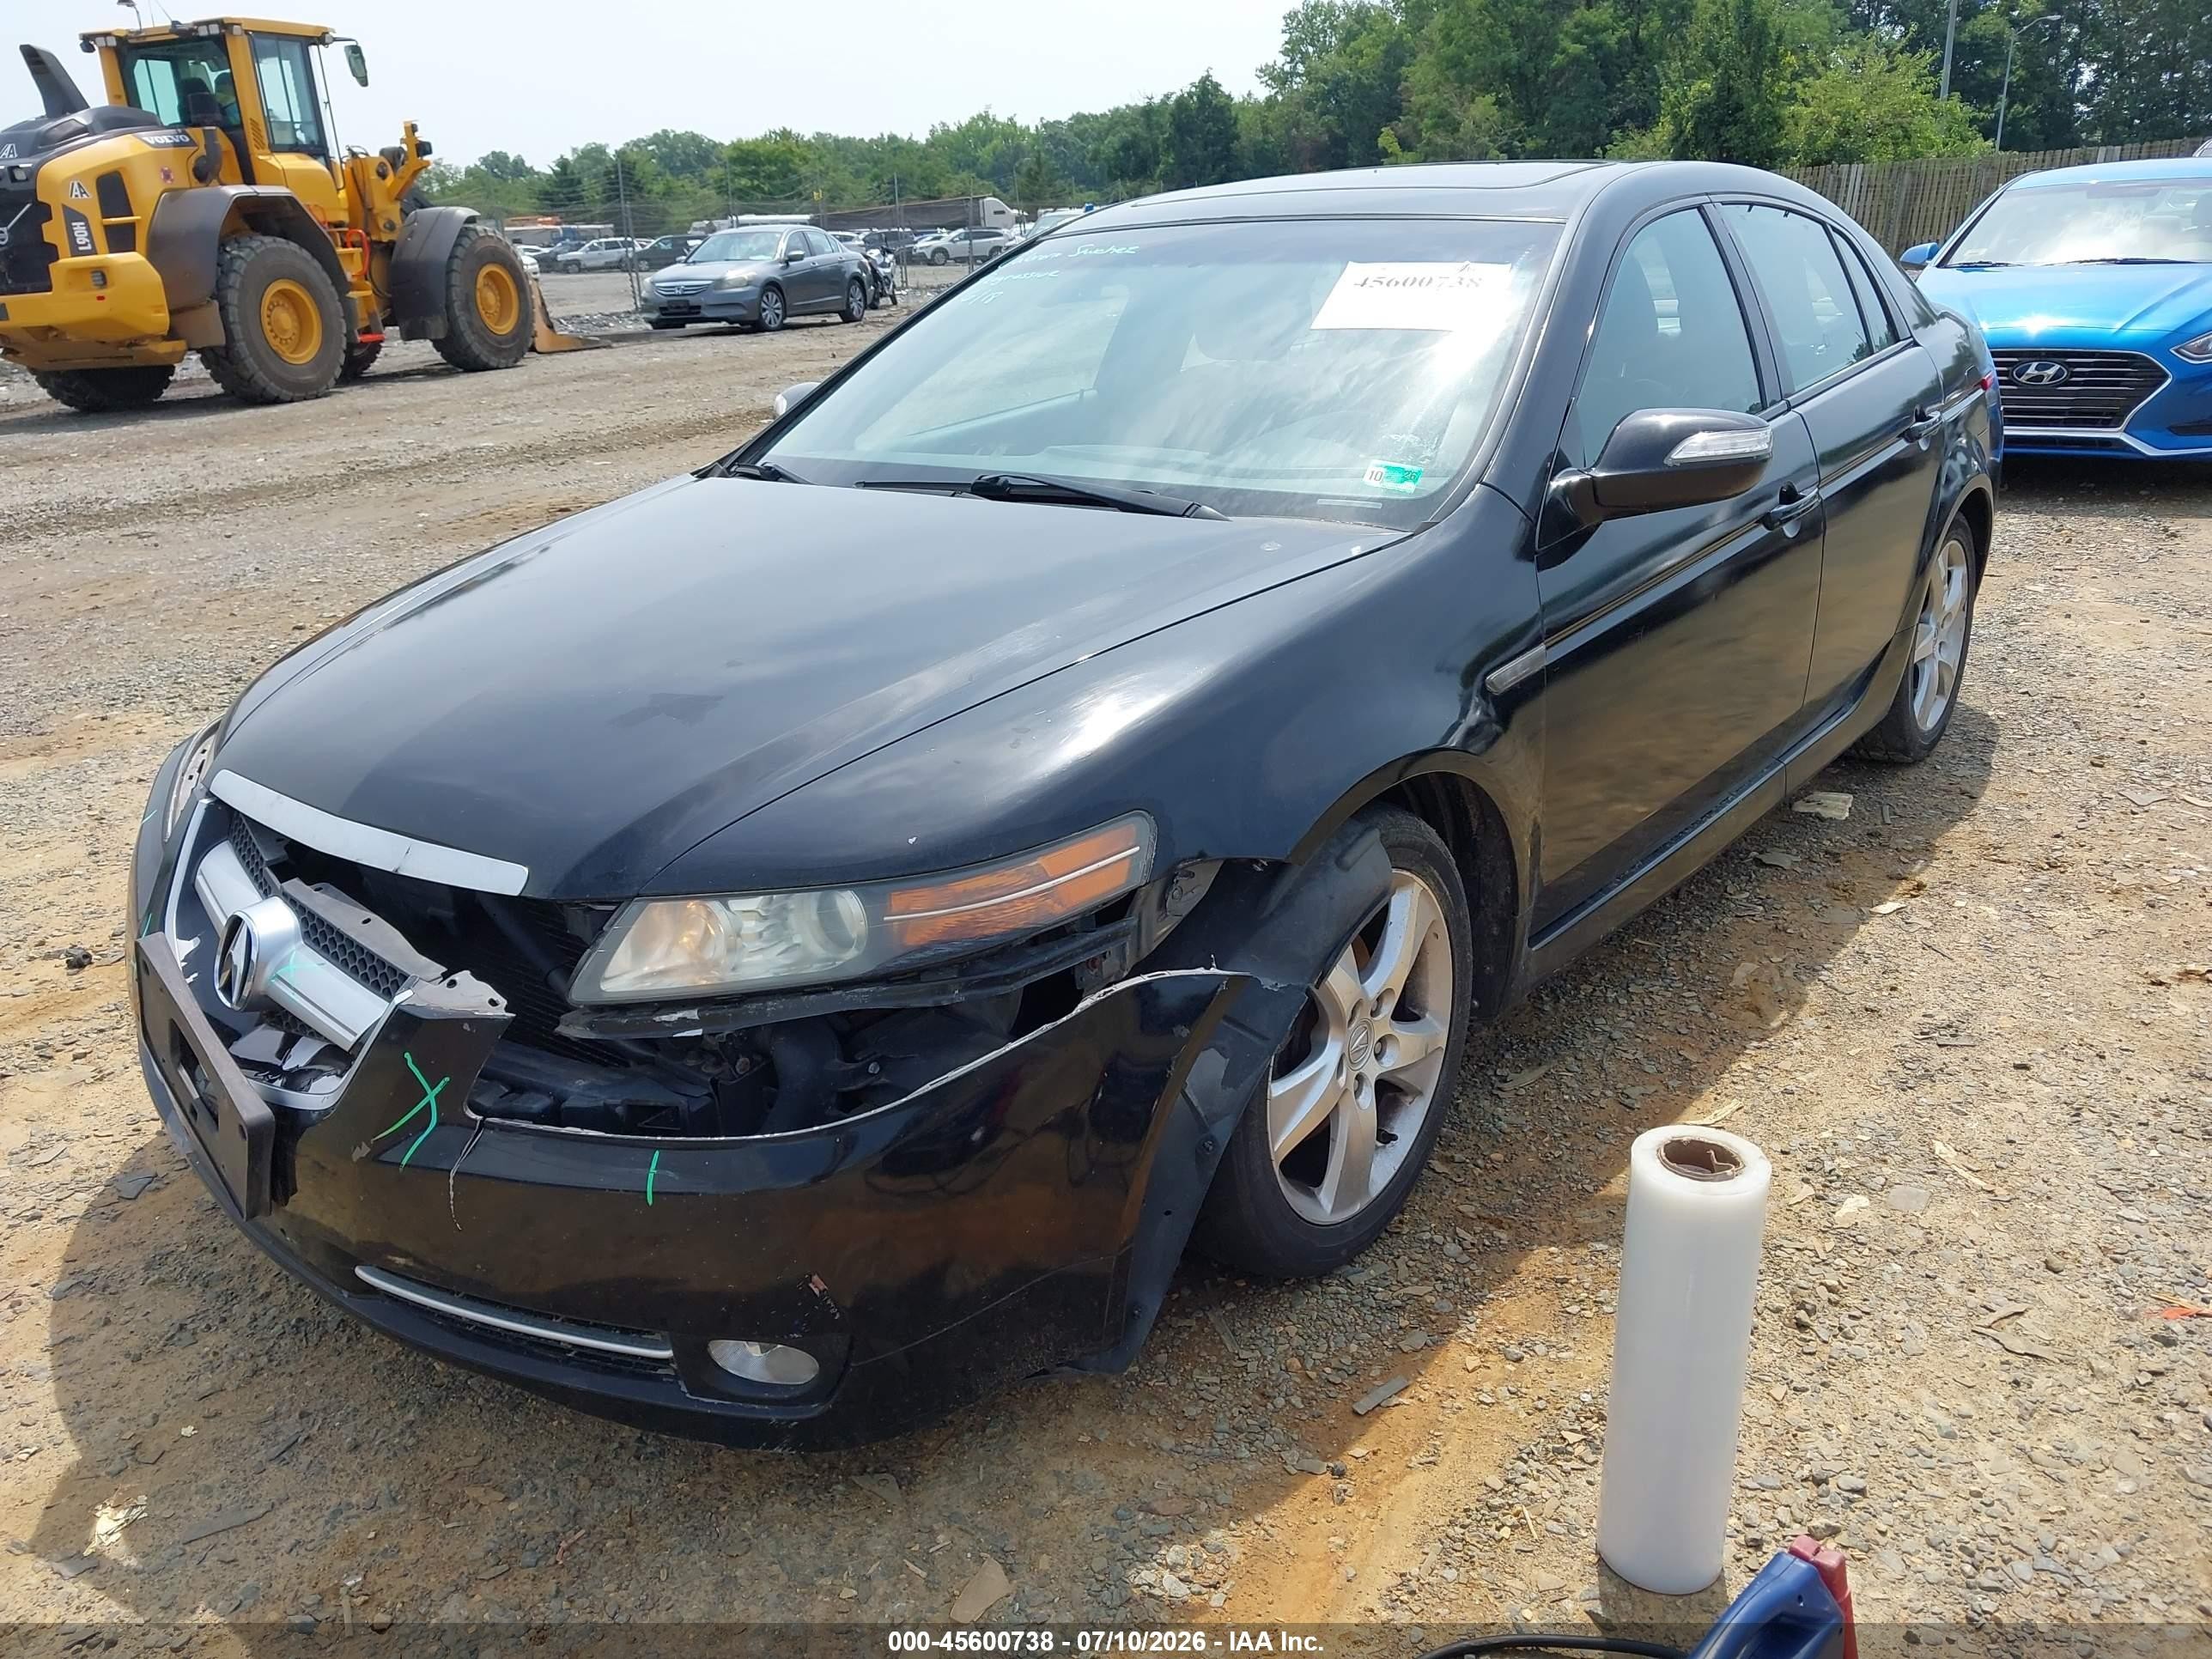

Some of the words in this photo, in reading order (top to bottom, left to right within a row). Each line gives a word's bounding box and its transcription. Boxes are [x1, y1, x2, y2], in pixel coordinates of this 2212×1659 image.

[142, 134, 190, 144] VOLVO
[71, 222, 92, 251] L90H
[1369, 470, 1383, 482] 10
